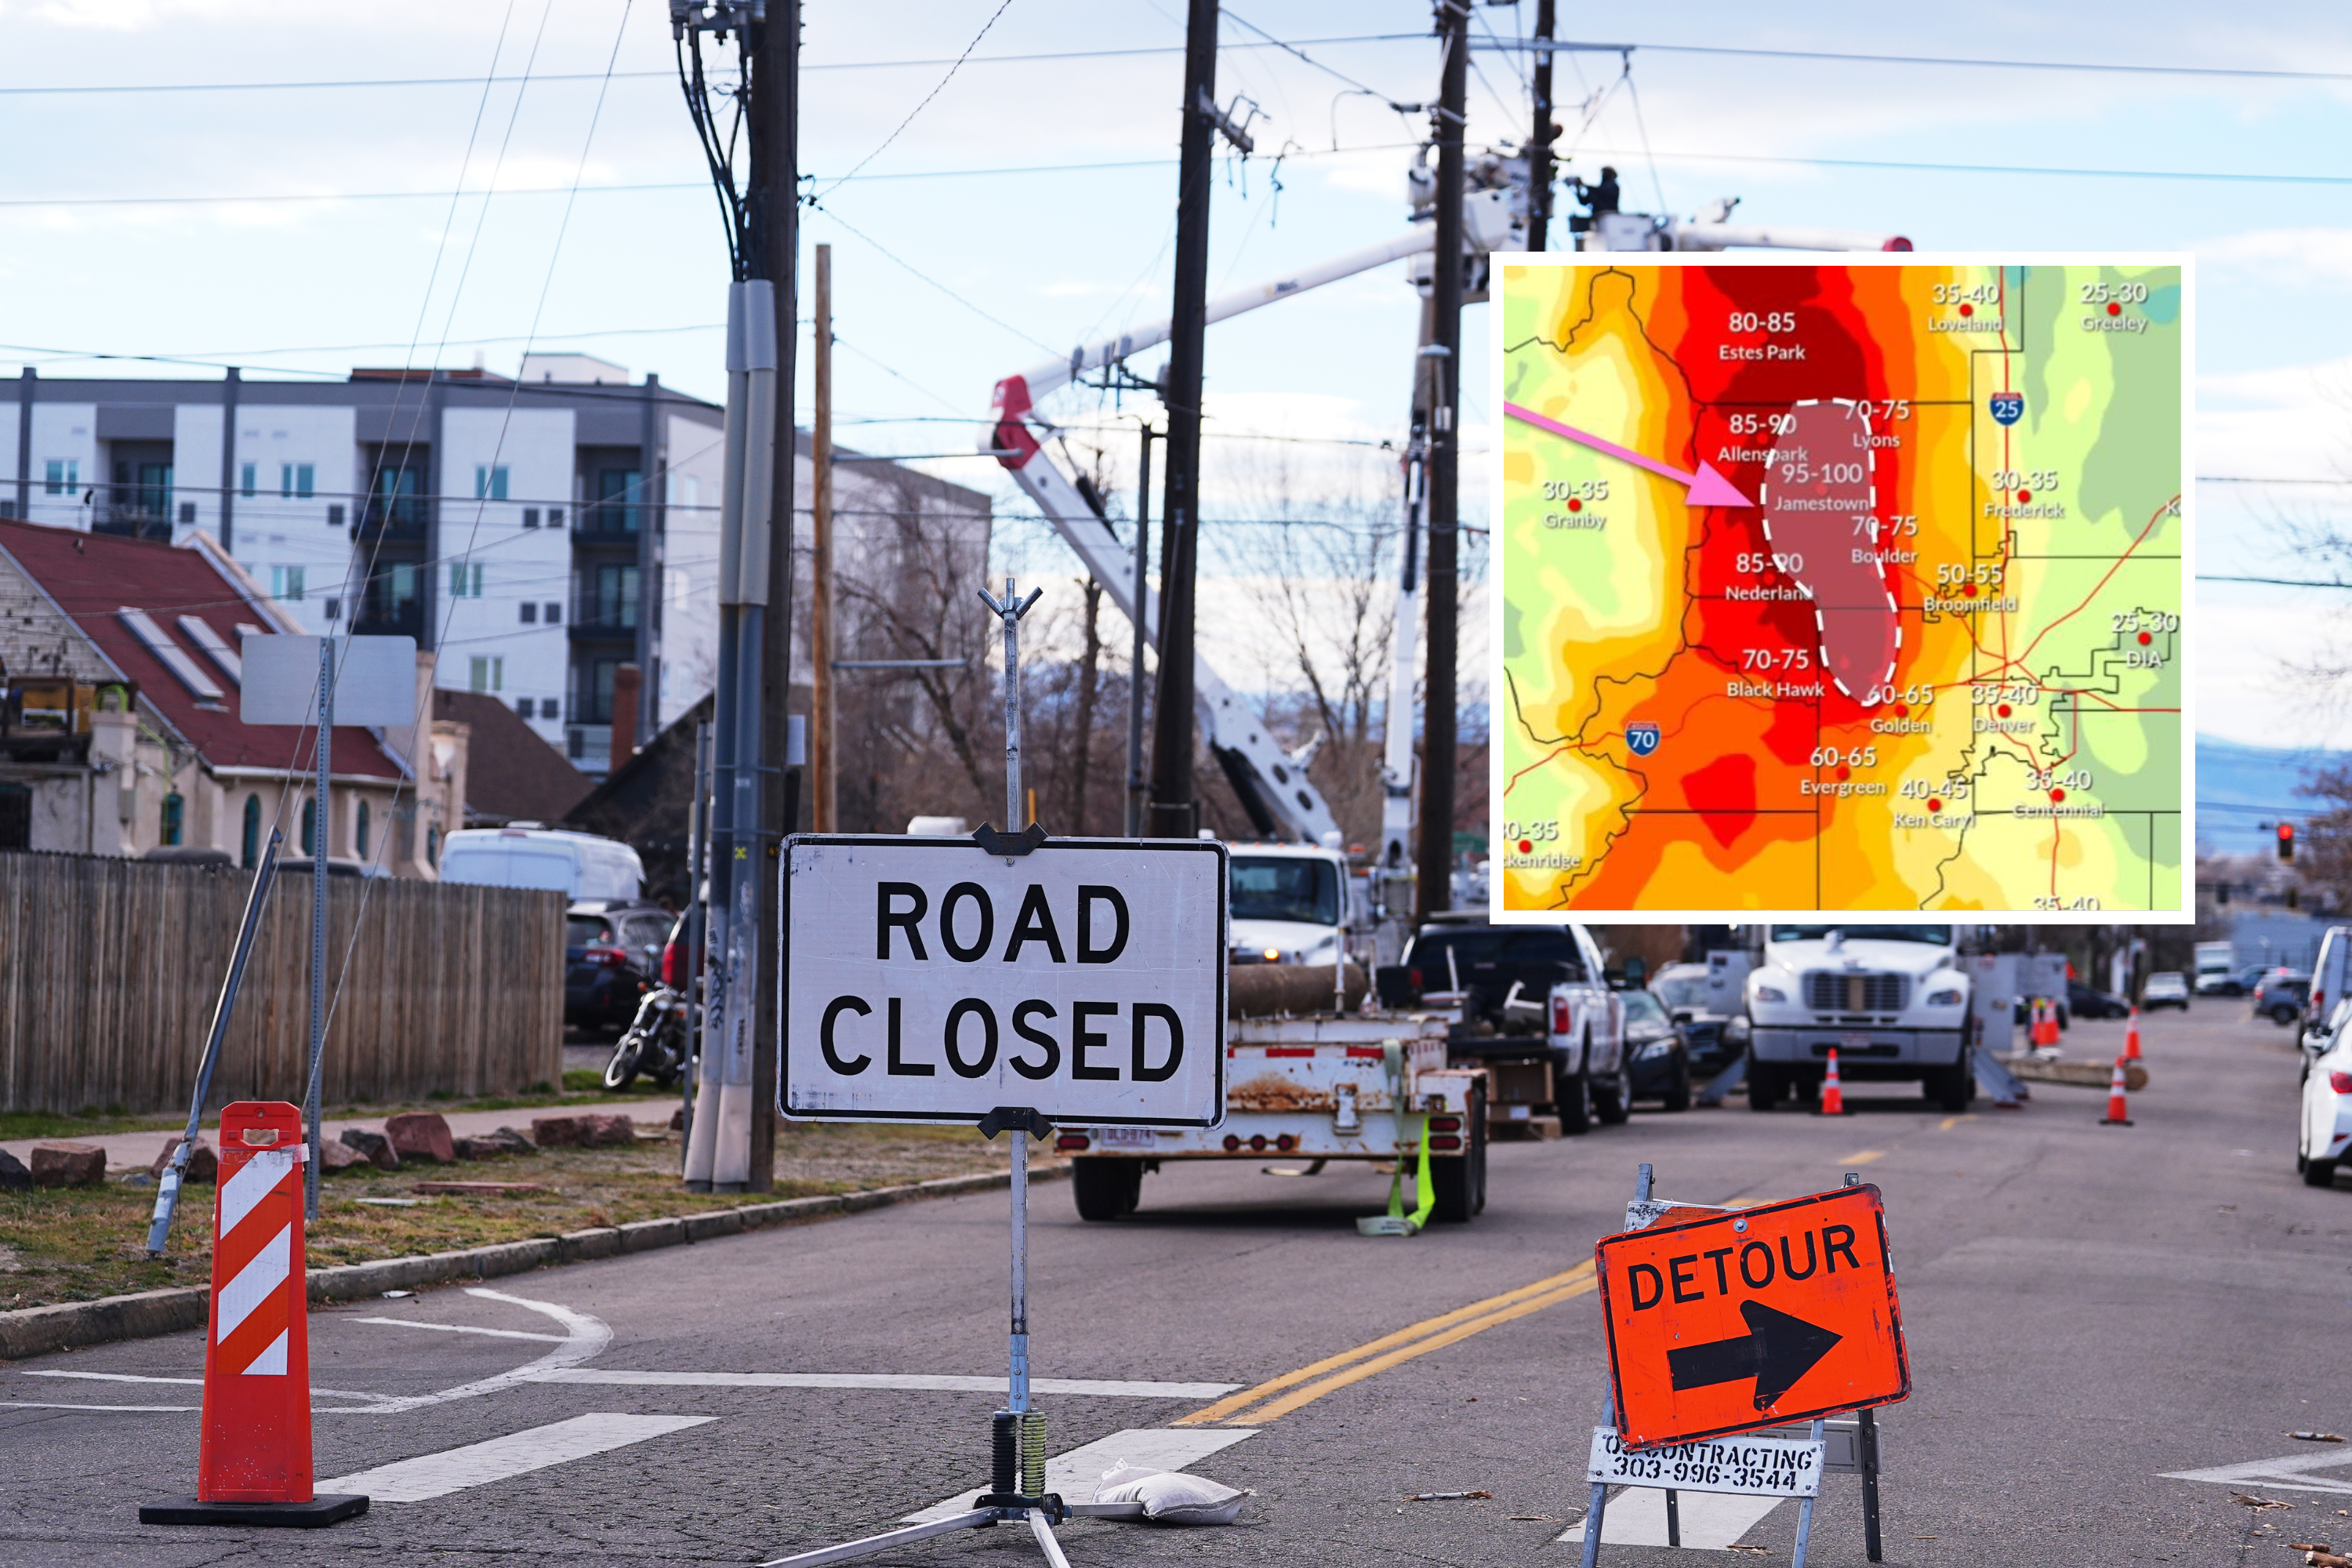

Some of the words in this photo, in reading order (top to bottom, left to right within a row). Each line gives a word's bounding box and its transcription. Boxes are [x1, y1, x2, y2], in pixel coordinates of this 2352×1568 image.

[877, 881, 1130, 964] ROAD
[820, 995, 1185, 1082] CLOSED
[1627, 1224, 1861, 1312] DETOUR
[1613, 1456, 1797, 1490] 303-996-3544
